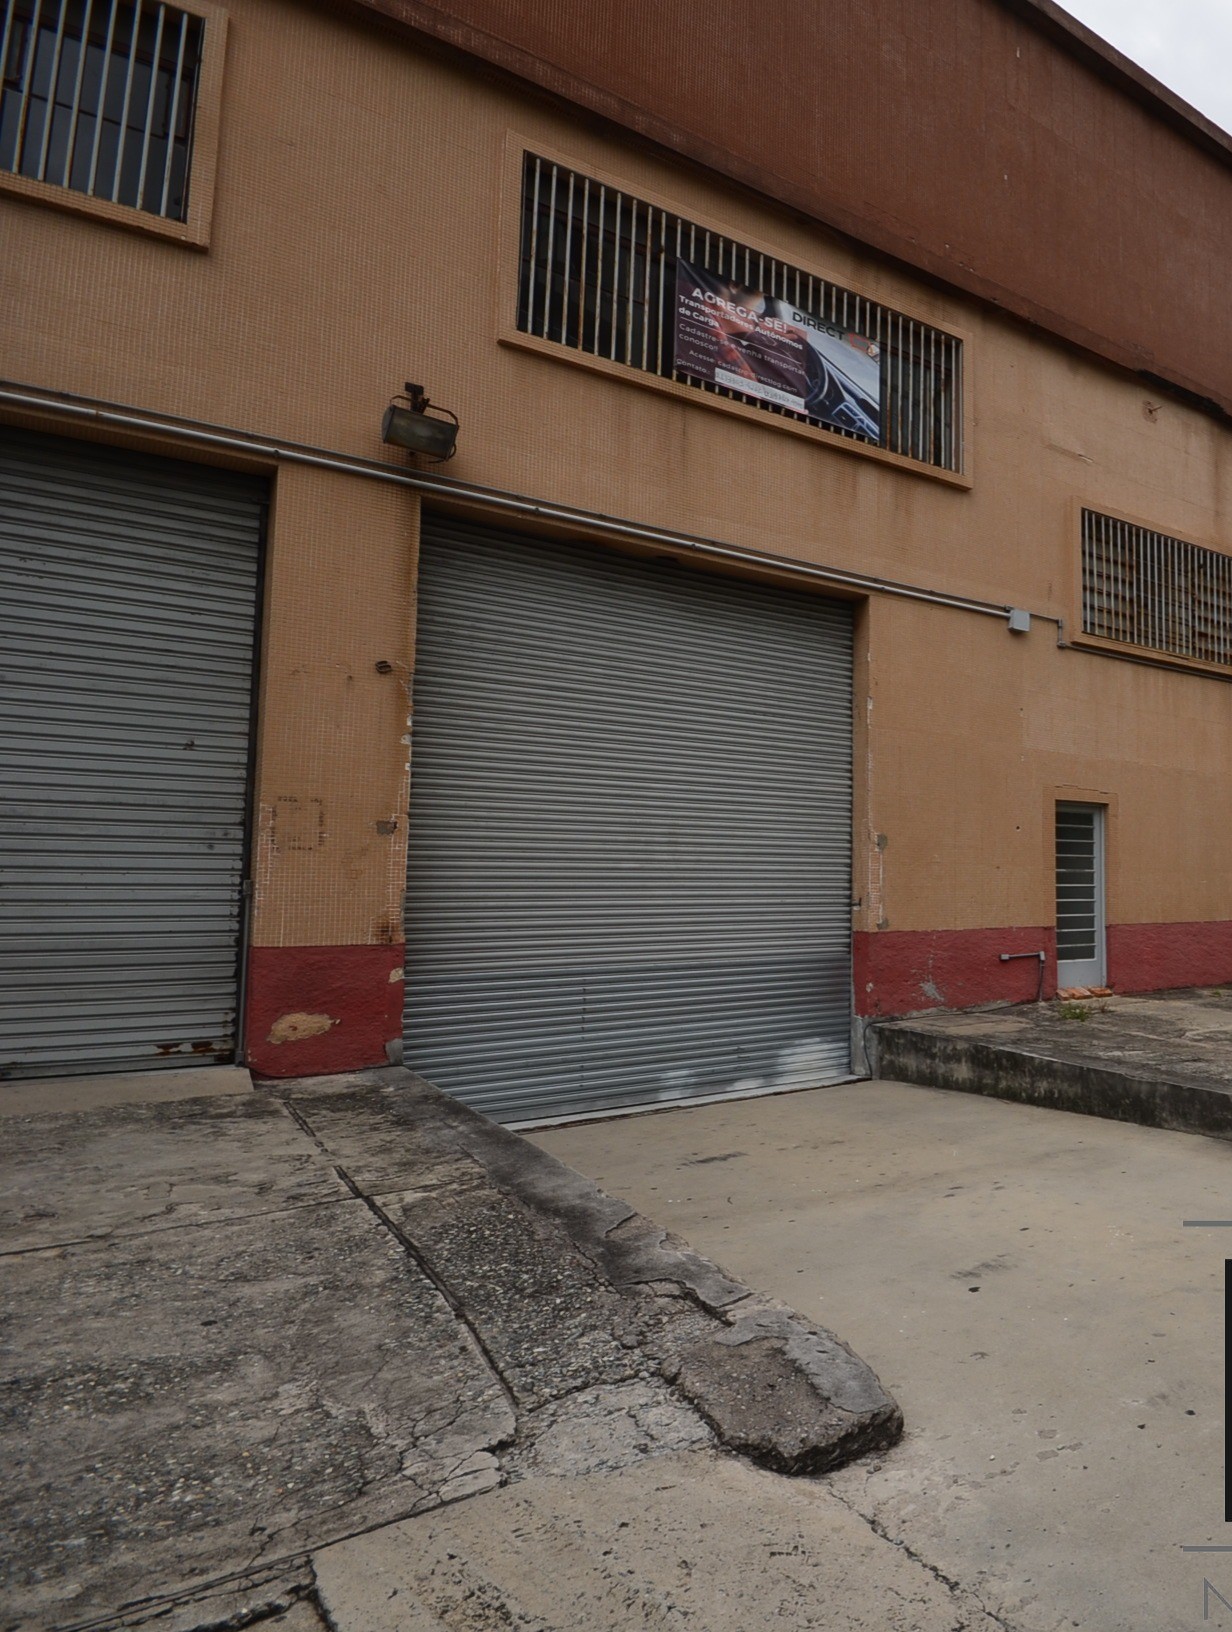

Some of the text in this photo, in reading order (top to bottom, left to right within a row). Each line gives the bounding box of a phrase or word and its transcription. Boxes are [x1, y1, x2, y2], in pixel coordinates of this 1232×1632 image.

[678, 306, 720, 328] de Carga
[678, 294, 803, 350] Transportadores Autônomos
[691, 287, 788, 334] AGREGA-SE!
[792, 311, 845, 341] DIRECT
[679, 323, 729, 345] Cadastre-se
[738, 345, 762, 359] venha
